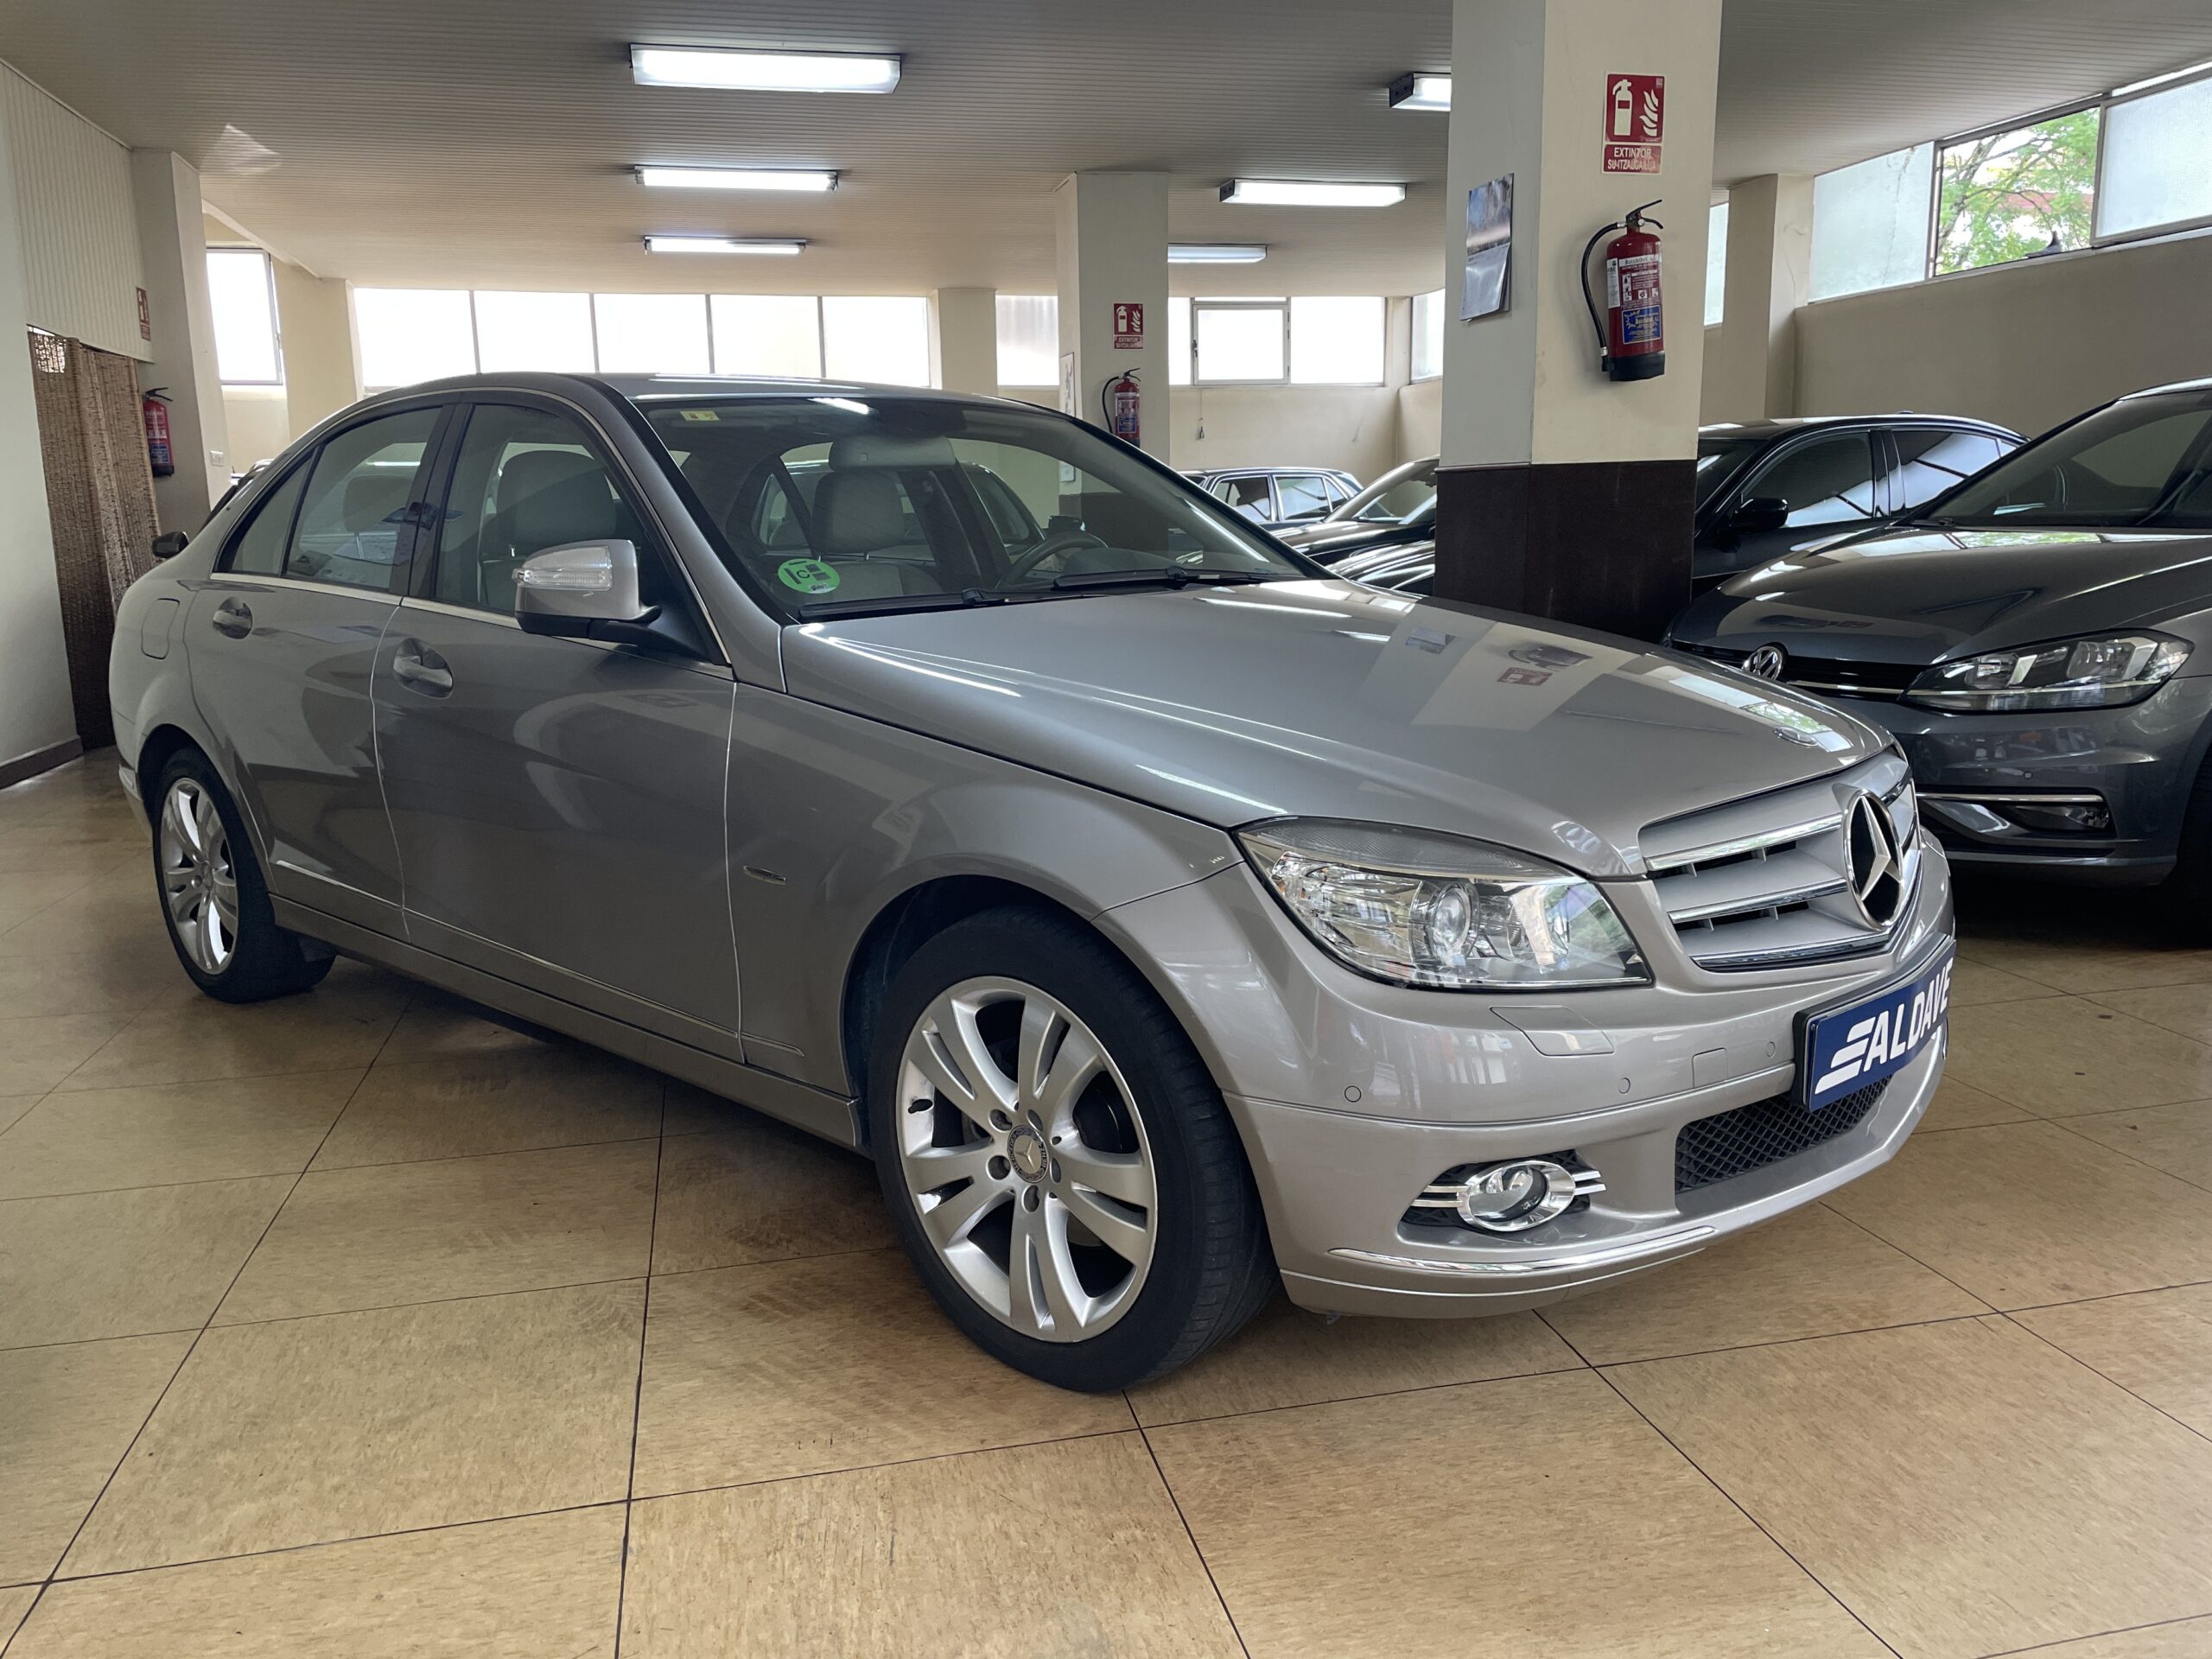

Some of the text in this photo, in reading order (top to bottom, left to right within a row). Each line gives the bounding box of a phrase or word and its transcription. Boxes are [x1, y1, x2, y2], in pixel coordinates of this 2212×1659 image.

[1613, 147, 1652, 159] EXTINTOR
[797, 569, 810, 579] C
[1863, 957, 1954, 1072] ALDAVE
